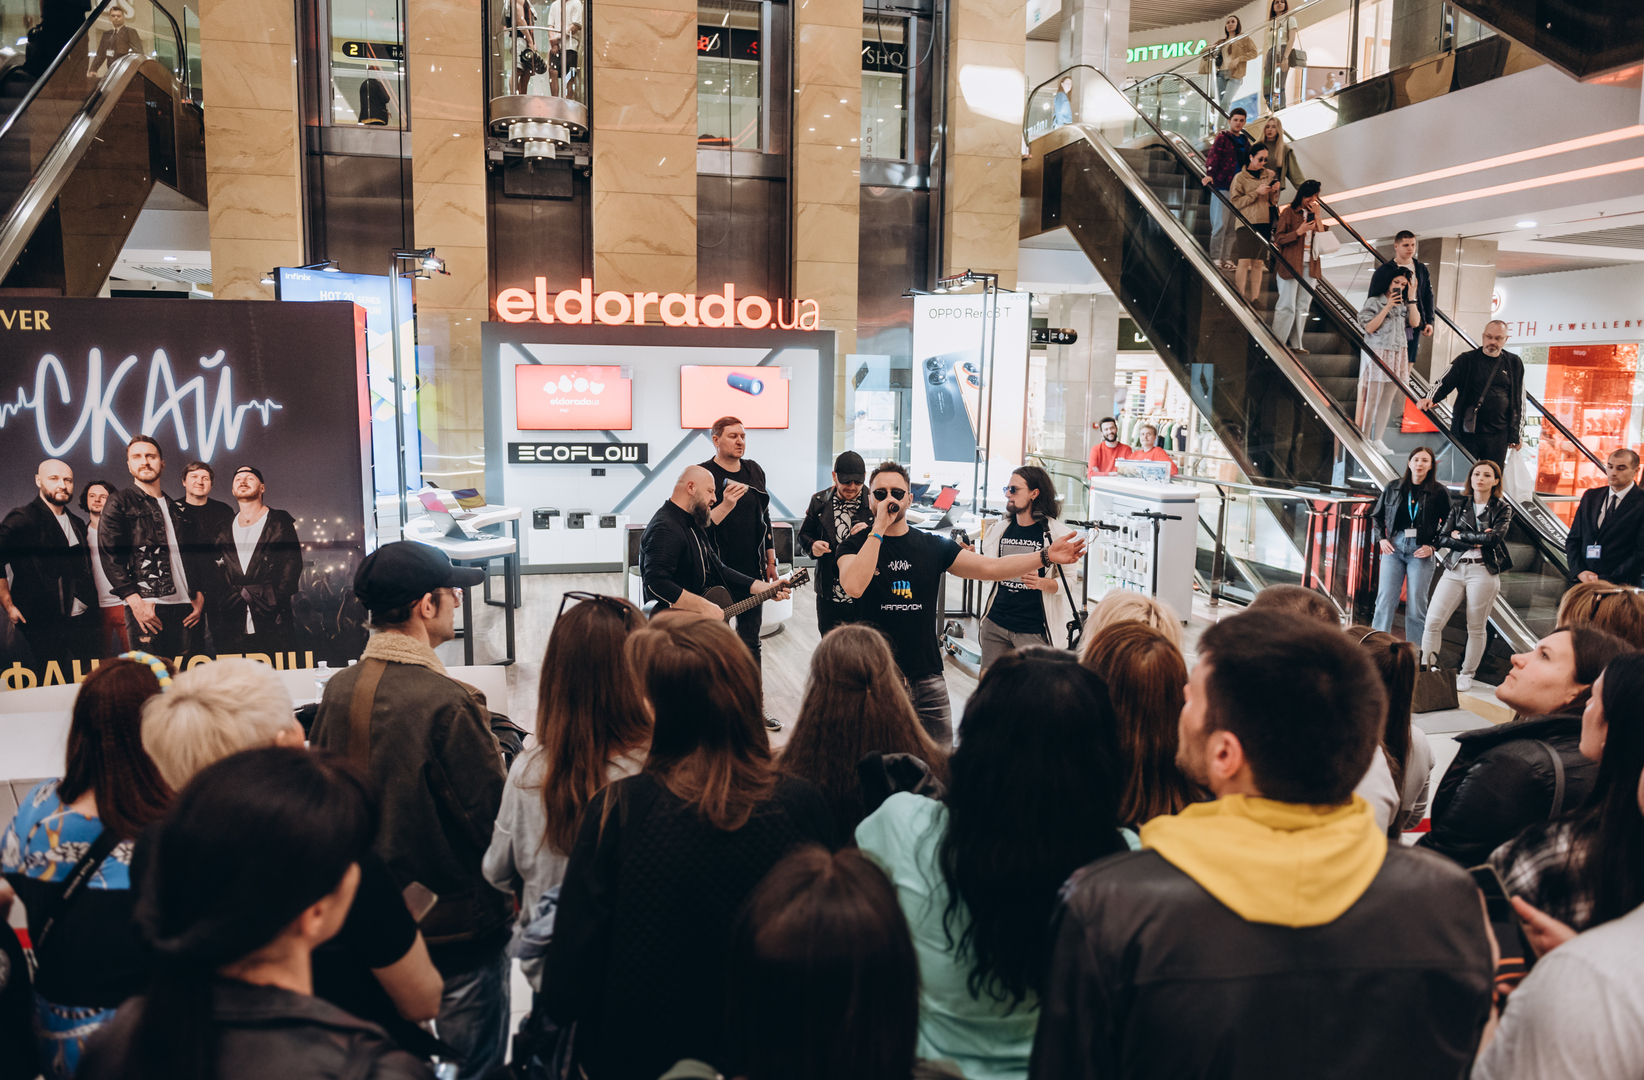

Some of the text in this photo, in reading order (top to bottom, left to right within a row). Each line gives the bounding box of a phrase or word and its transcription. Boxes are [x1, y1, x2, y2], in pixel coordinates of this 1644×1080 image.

[349, 43, 359, 56] 2
[320, 290, 341, 301] HOT
[343, 292, 354, 301] 20
[496, 276, 820, 331] eldorado.ua
[928, 308, 962, 319] OPPO
[1004, 306, 1011, 317] T
[1548, 319, 1643, 332] JEWELLERY
[33, 347, 250, 464] СКАЙ
[518, 445, 639, 461] ECOFLOW
